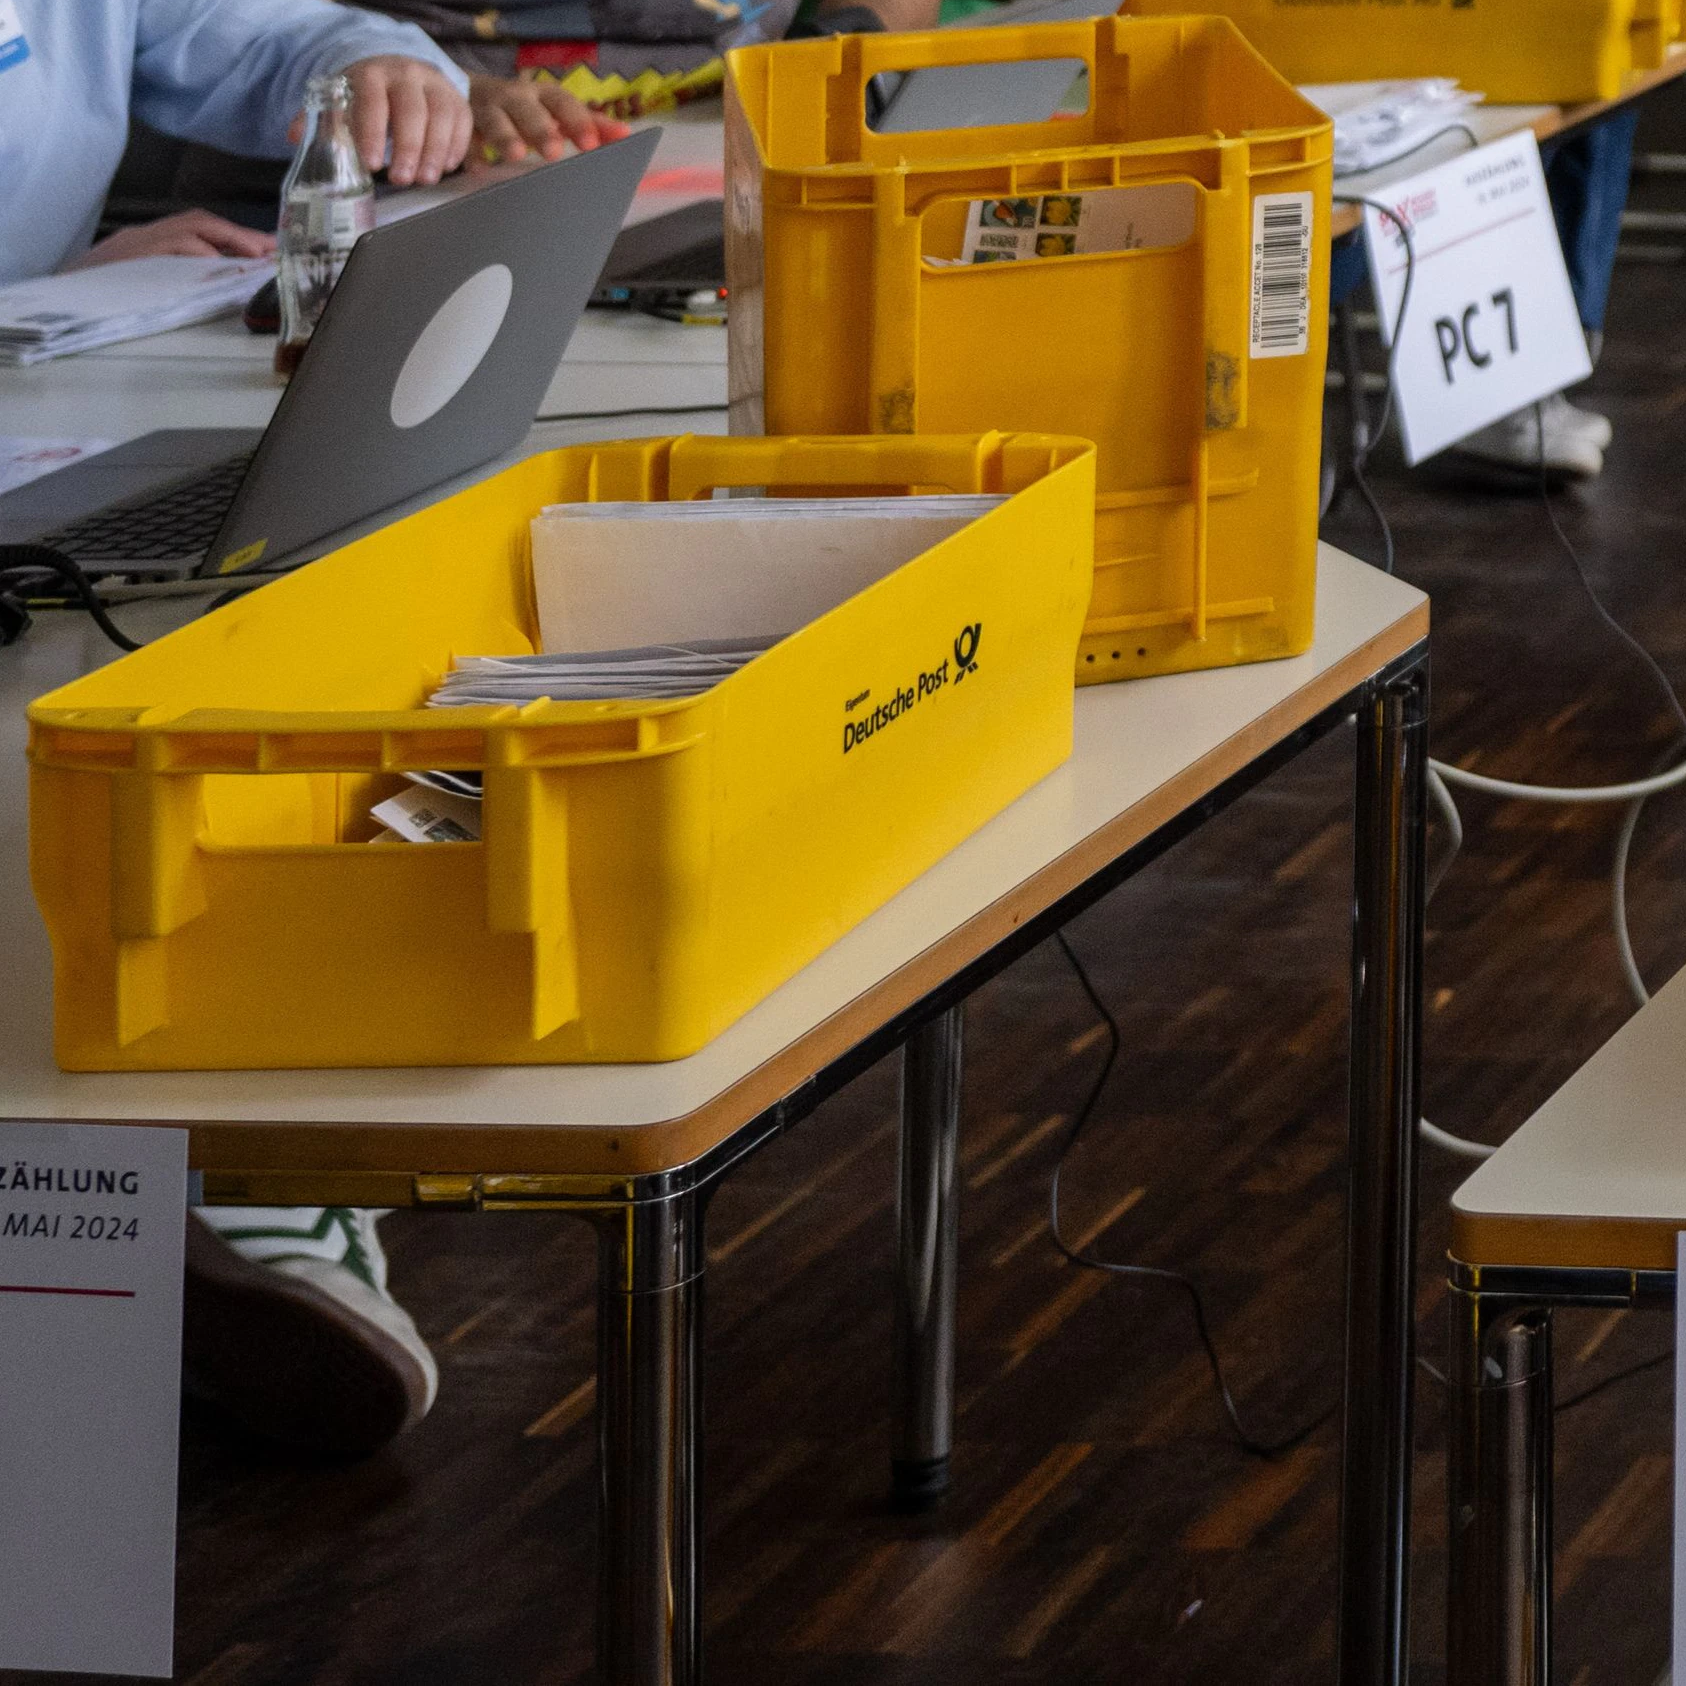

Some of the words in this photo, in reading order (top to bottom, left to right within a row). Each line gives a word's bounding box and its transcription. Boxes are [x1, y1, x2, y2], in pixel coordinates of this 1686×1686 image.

[1434, 301, 1492, 385] PC
[1492, 284, 1519, 354] 7
[843, 687, 915, 755] Deutsche
[917, 658, 949, 703] Post
[2, 1213, 61, 1238] MAI
[69, 1215, 140, 1242] 2024
